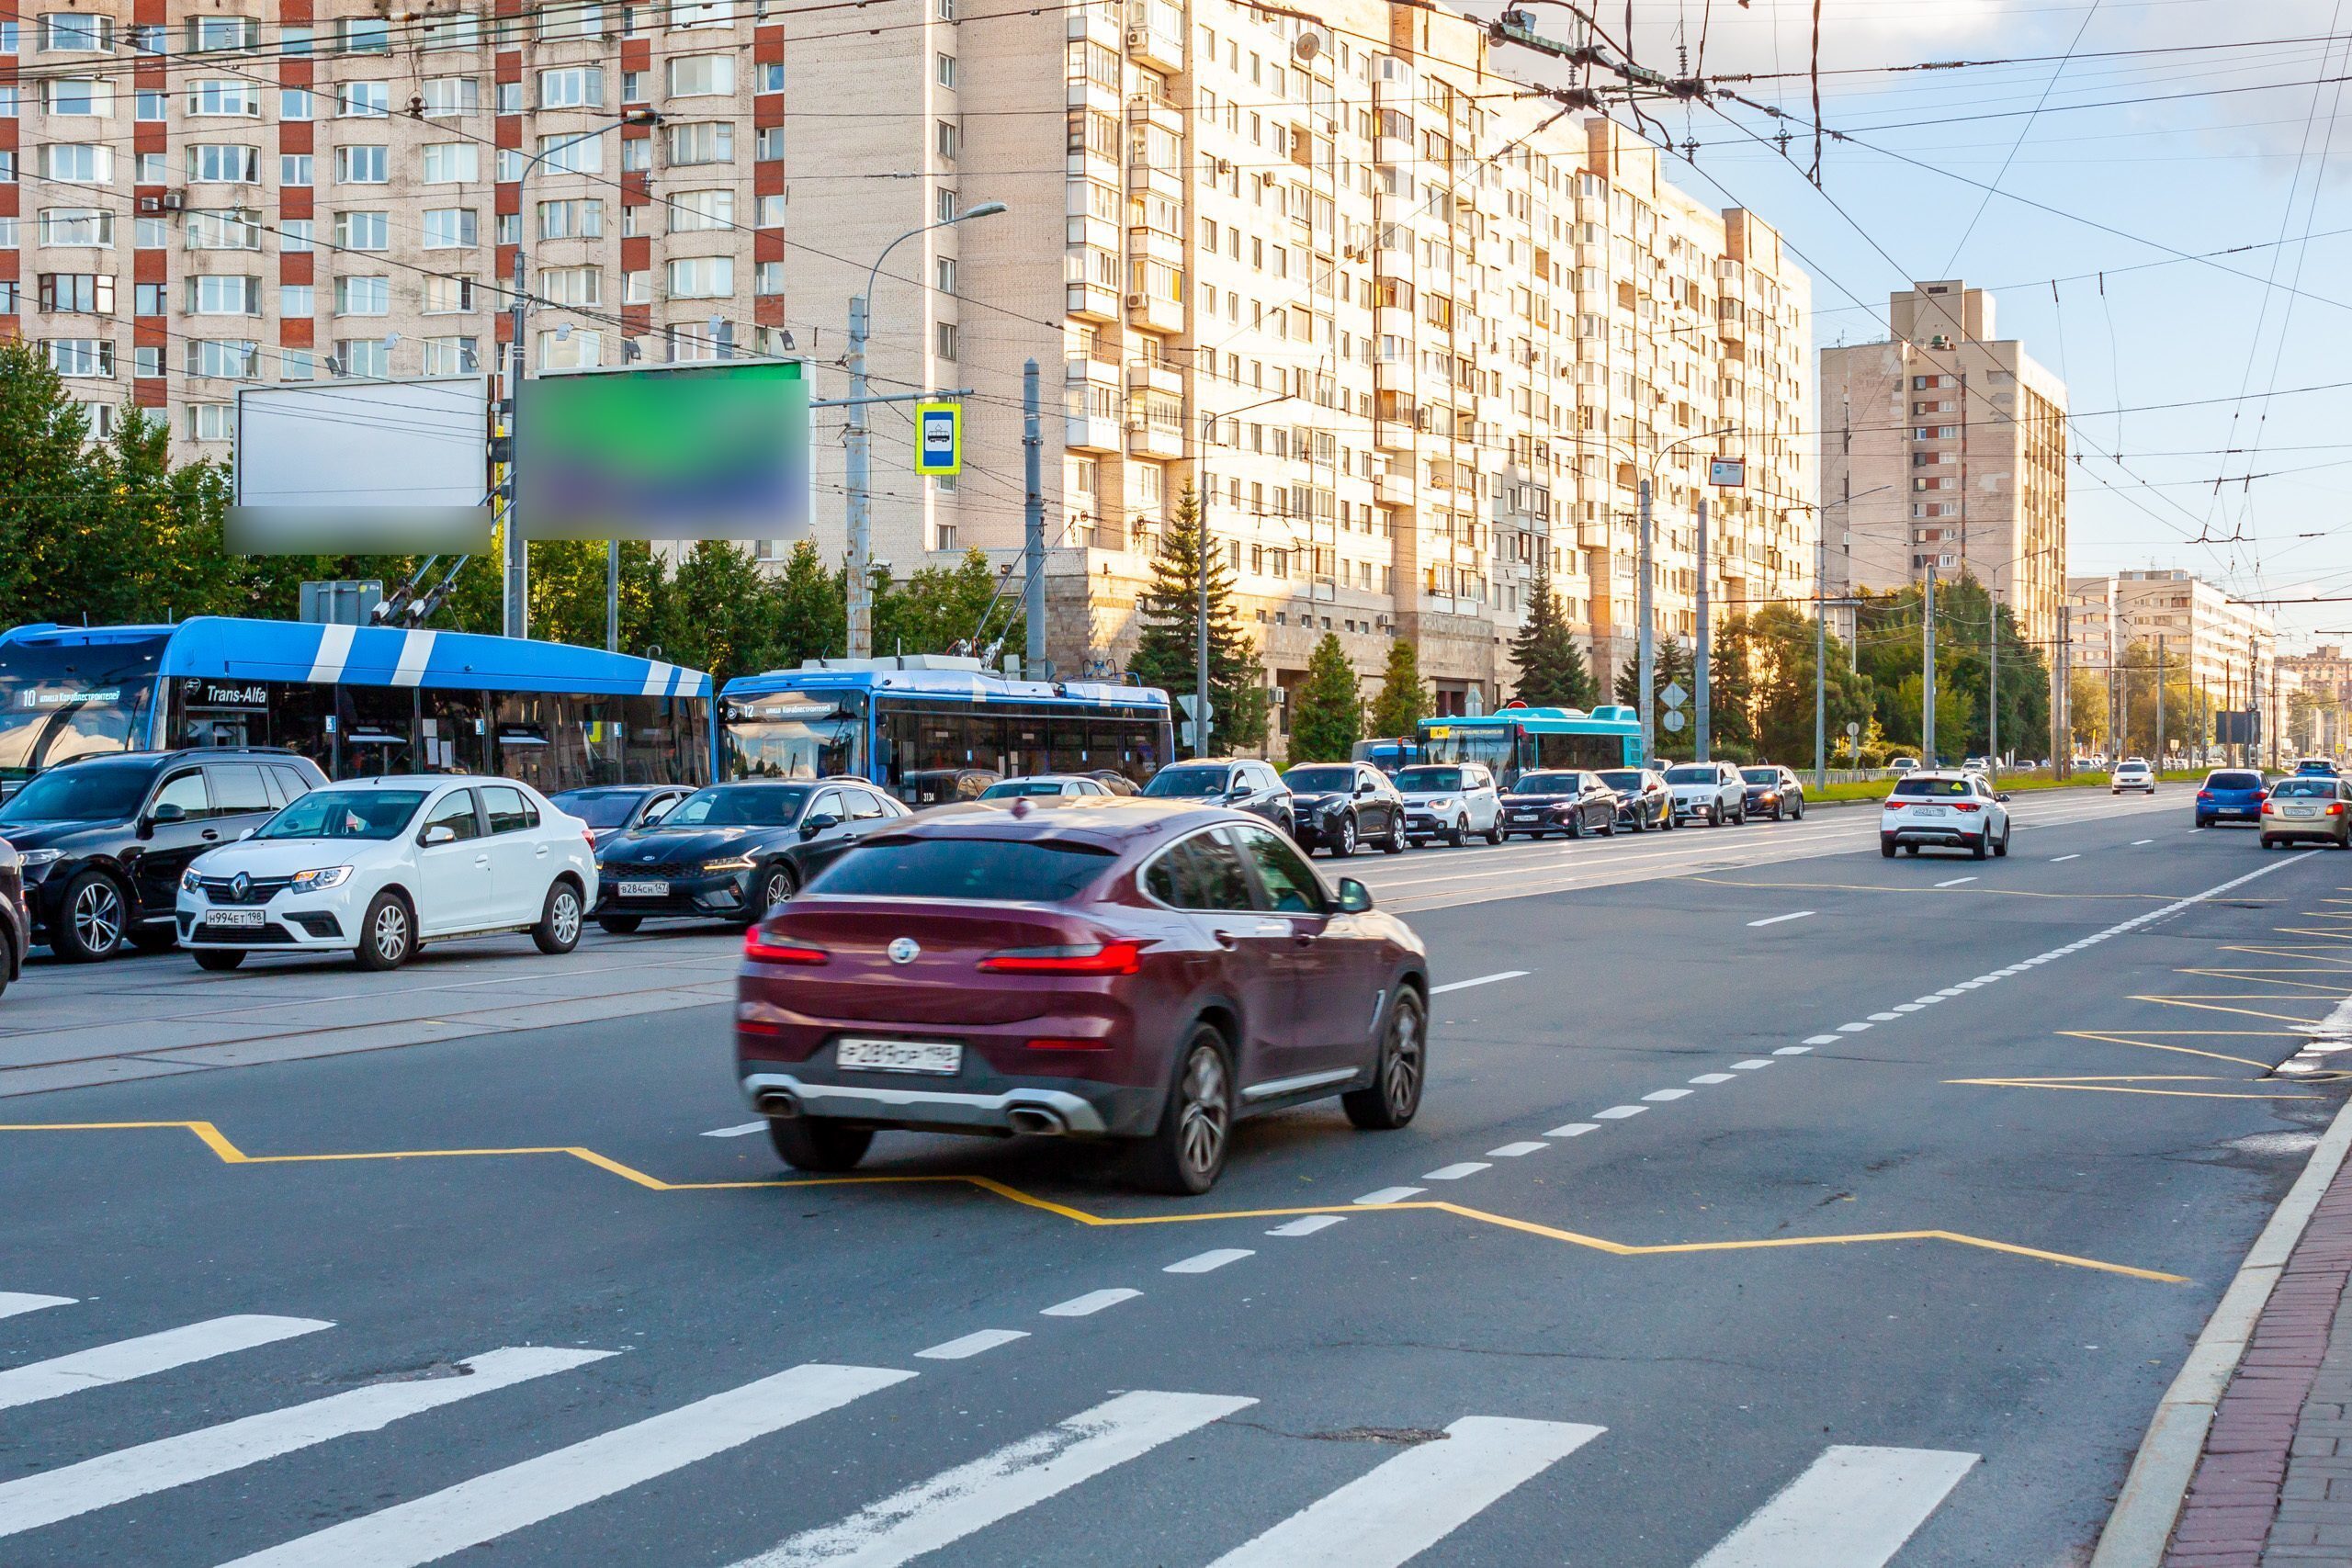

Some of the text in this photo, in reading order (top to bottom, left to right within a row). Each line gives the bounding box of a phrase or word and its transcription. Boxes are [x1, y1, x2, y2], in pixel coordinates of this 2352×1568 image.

[23, 689, 36, 707] 10
[59, 691, 120, 702] Кораблестроителей
[208, 684, 266, 704] Trans-Alfa
[743, 705, 754, 717] 12
[1436, 728, 1442, 737] 6
[622, 883, 667, 894] В284СН 147
[209, 912, 262, 924] Н994ЕТ 198
